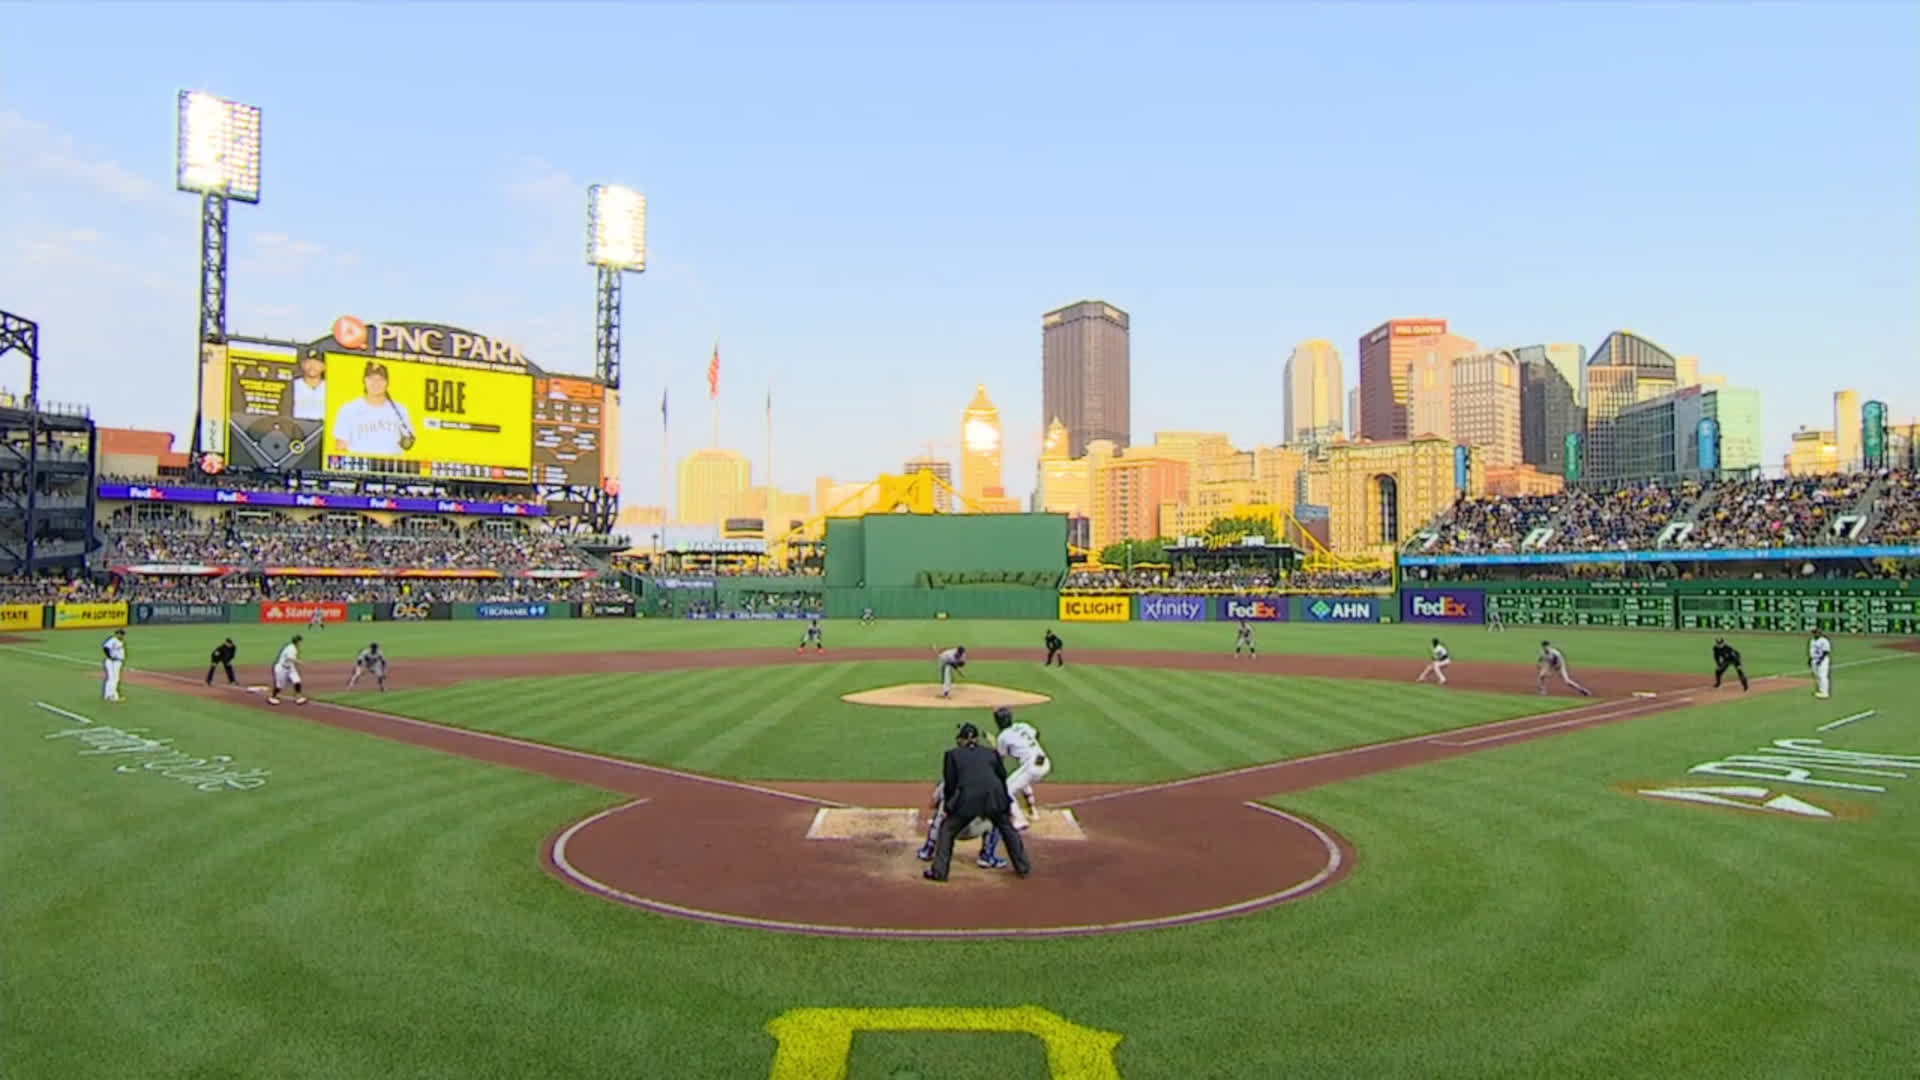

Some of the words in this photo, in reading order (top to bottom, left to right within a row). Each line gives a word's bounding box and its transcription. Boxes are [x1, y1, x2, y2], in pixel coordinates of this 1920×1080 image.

[375, 323, 444, 355] PNC
[450, 332, 528, 366] PARK
[425, 378, 467, 414] BAE
[1066, 602, 1081, 615] IC
[1083, 602, 1123, 615] LIGHT
[1145, 599, 1200, 618] xfinity
[1228, 601, 1277, 618] FedEx
[1332, 603, 1370, 618] AHN
[1413, 596, 1467, 616] FedEx
[0, 610, 29, 620] STATE
[93, 610, 126, 620] LOTTERY
